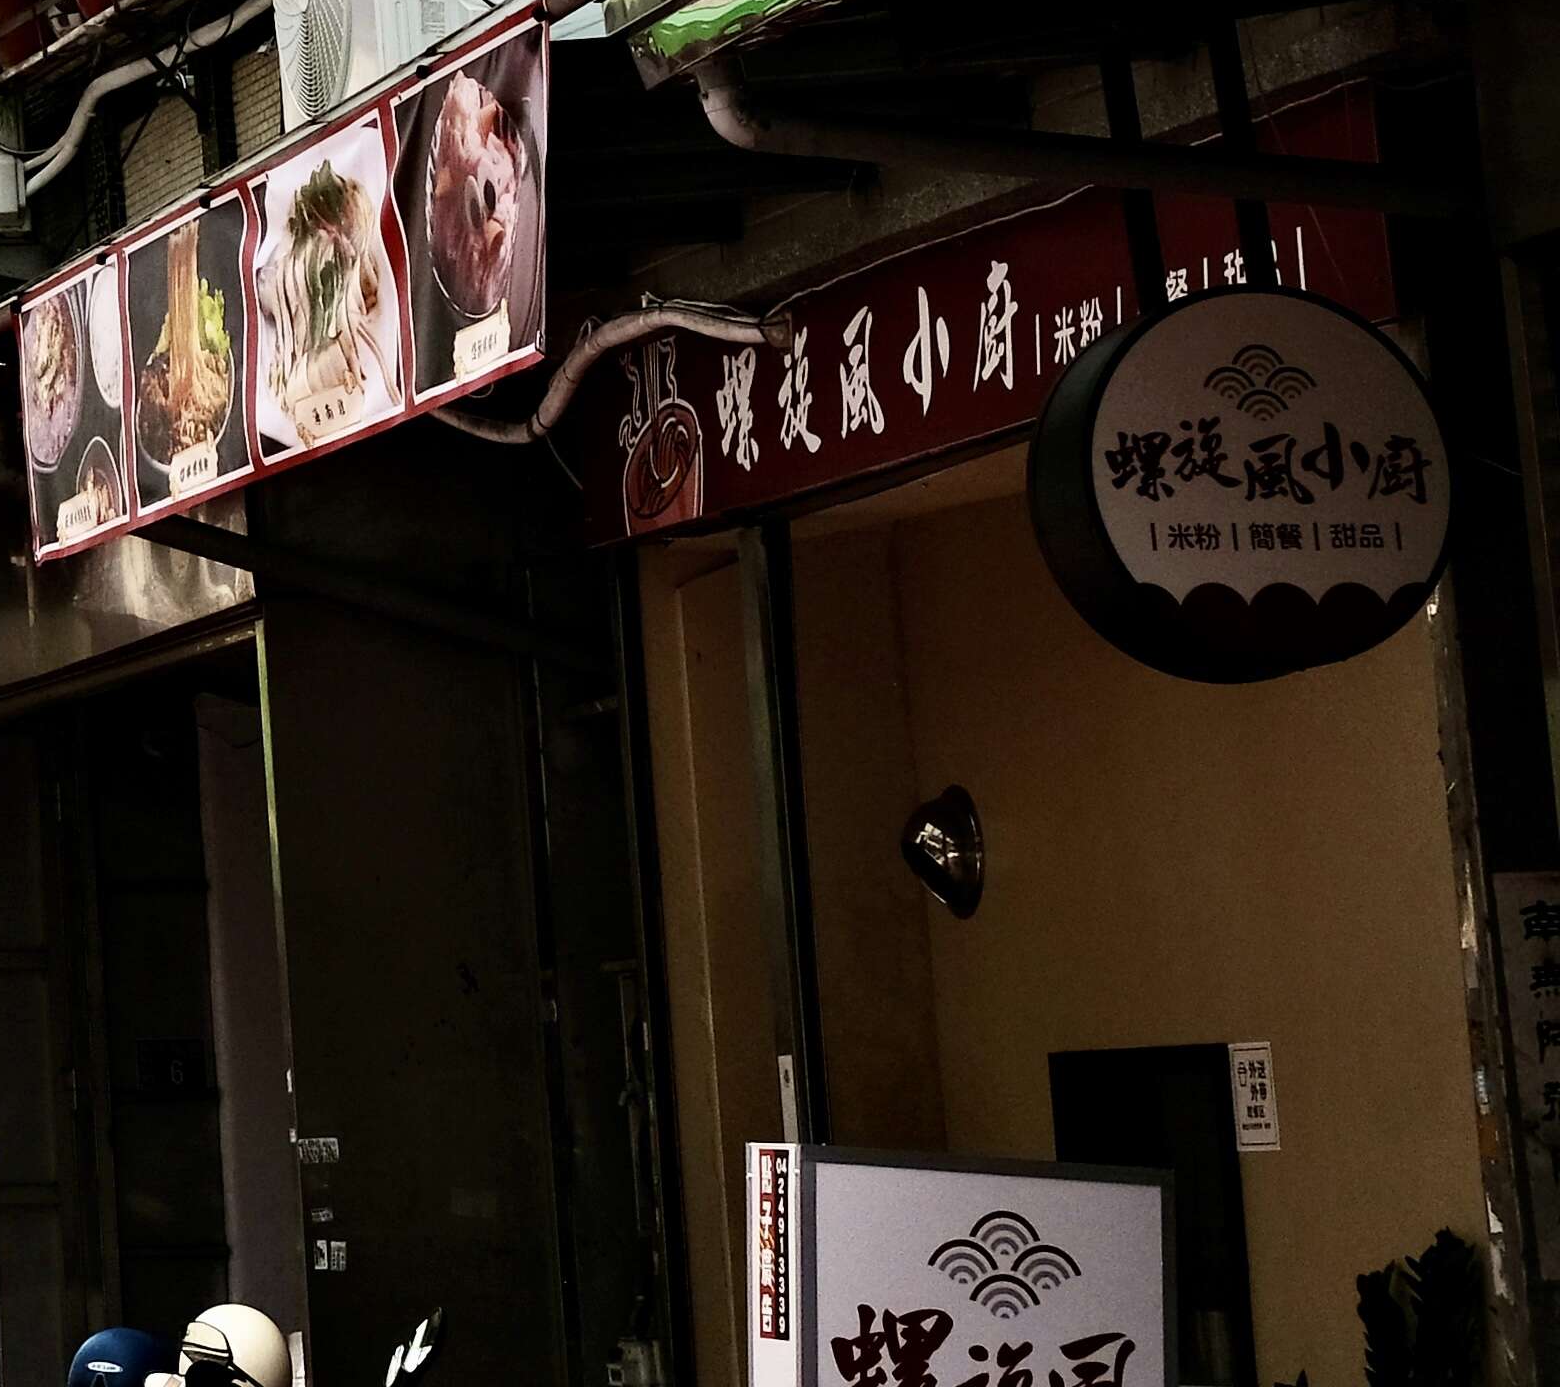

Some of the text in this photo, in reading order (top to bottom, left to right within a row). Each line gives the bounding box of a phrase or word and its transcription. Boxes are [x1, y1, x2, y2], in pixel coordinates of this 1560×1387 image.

[1053, 295, 1104, 365] 米粉
[1167, 523, 1386, 552] 米粉 簡餐 甜品
